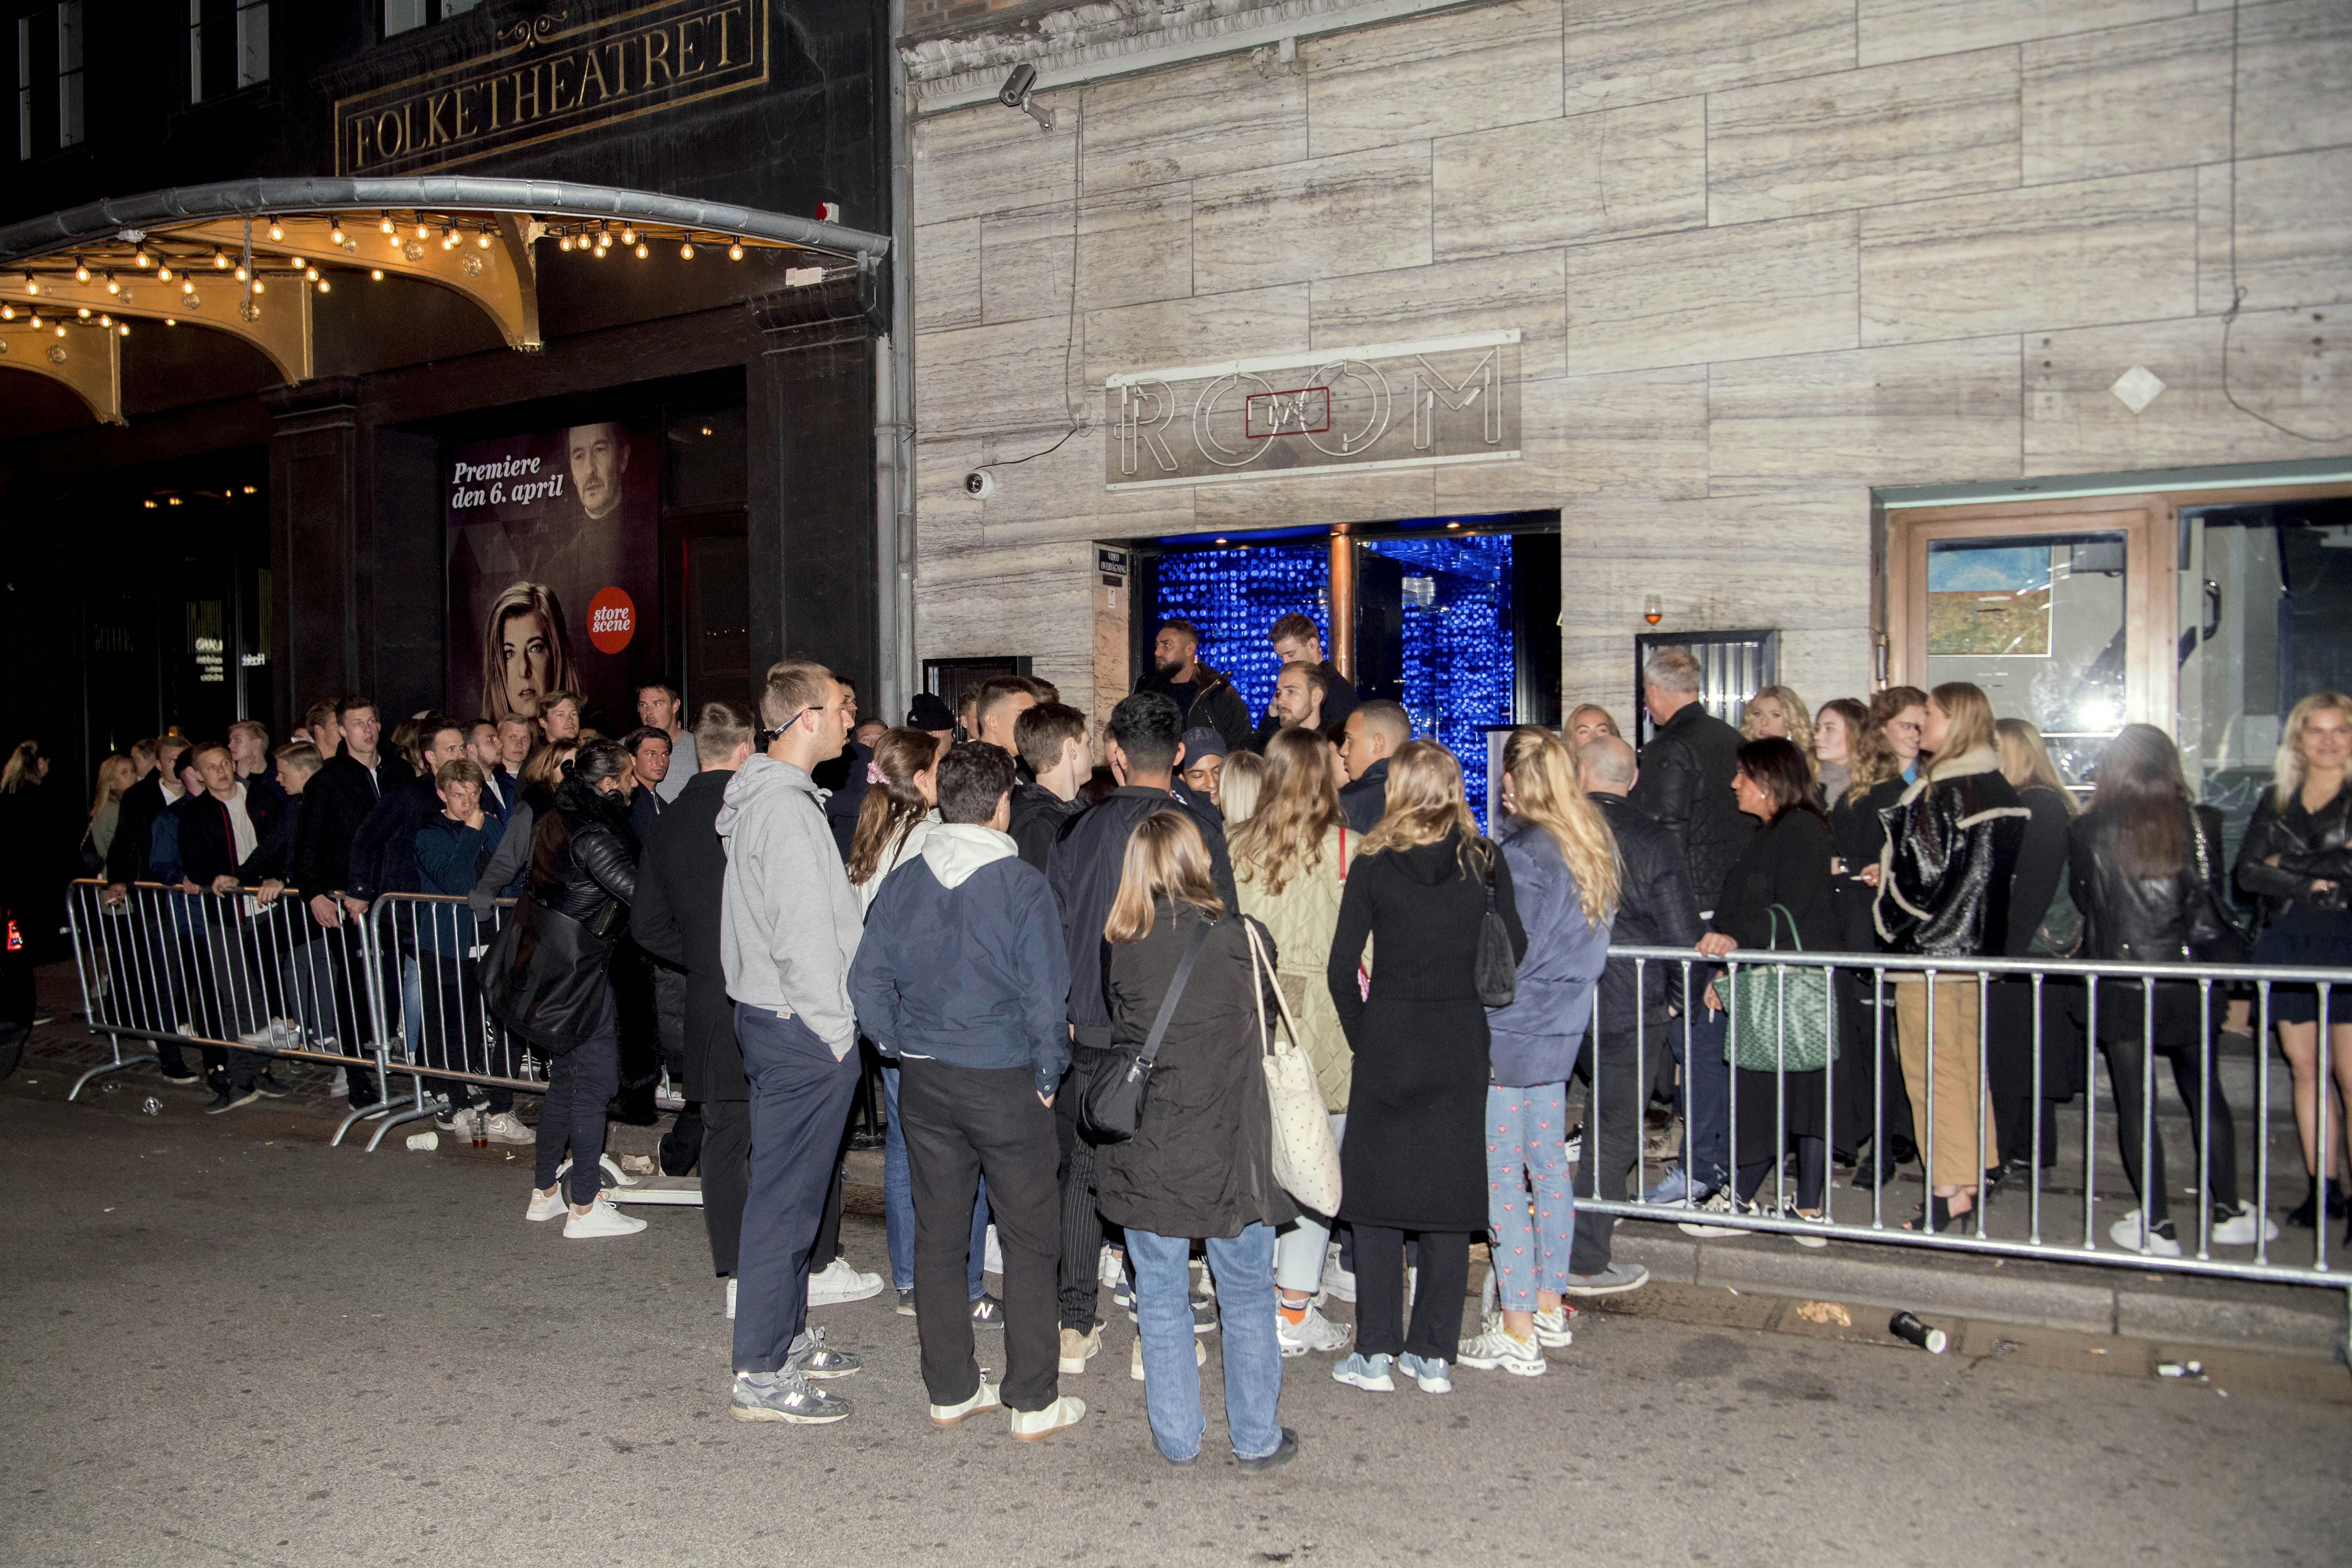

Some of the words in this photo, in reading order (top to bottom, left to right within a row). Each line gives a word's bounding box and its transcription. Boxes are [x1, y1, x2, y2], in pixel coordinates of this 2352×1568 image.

[355, 6, 742, 167] FOLKETHEATRET
[1114, 345, 1502, 475] ROOM
[452, 455, 540, 484] Premiere
[452, 487, 486, 509] den
[490, 482, 506, 504] 6.
[512, 474, 564, 505] april
[1108, 552, 1119, 562] VIDEO
[594, 606, 629, 621] store
[593, 619, 630, 632] scene
[973, 1302, 994, 1319] N
[813, 1352, 828, 1366] N
[784, 1391, 804, 1407] N
